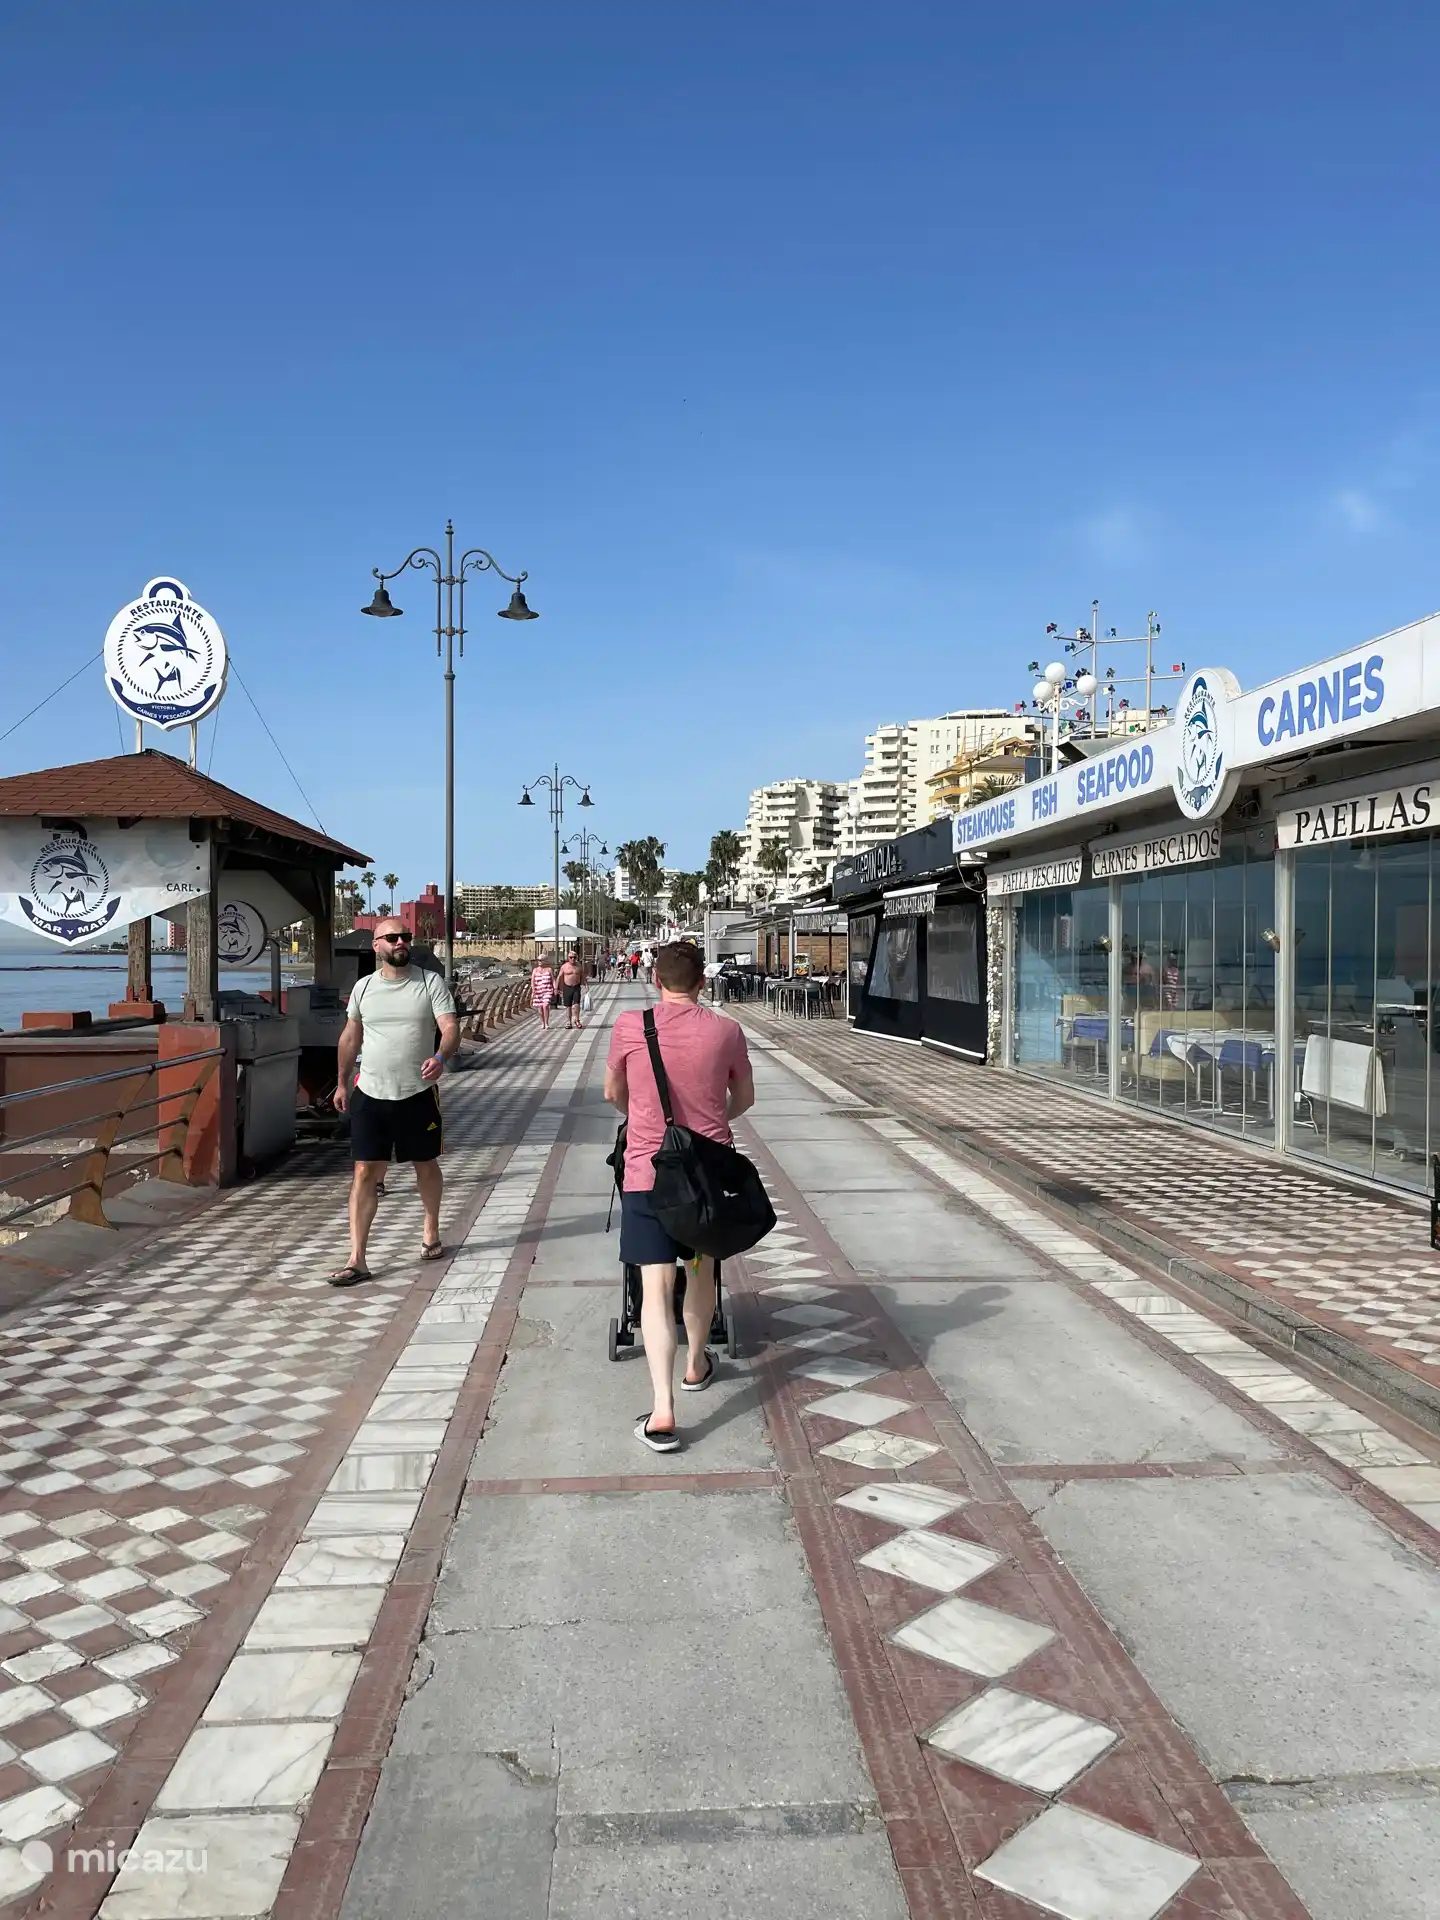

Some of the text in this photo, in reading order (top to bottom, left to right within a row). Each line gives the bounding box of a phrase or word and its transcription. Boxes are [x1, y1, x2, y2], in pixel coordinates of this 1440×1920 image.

[130, 600, 203, 621] RESTAURANTE
[136, 706, 158, 719] CARNES
[162, 709, 191, 720] PESCADOS
[1257, 655, 1385, 747] CARNES
[957, 744, 1154, 845] STEAKHOUSE FISH SEAFOOD
[1294, 786, 1431, 844] PAELLAS
[40, 838, 99, 853] RESTAURANTE
[1092, 826, 1220, 876] CARNES PESCADOS
[166, 882, 194, 892] CARL
[1002, 860, 1080, 892] PAELLA PESCAITOS
[32, 916, 62, 934] MAR
[77, 917, 108, 934] MAR
